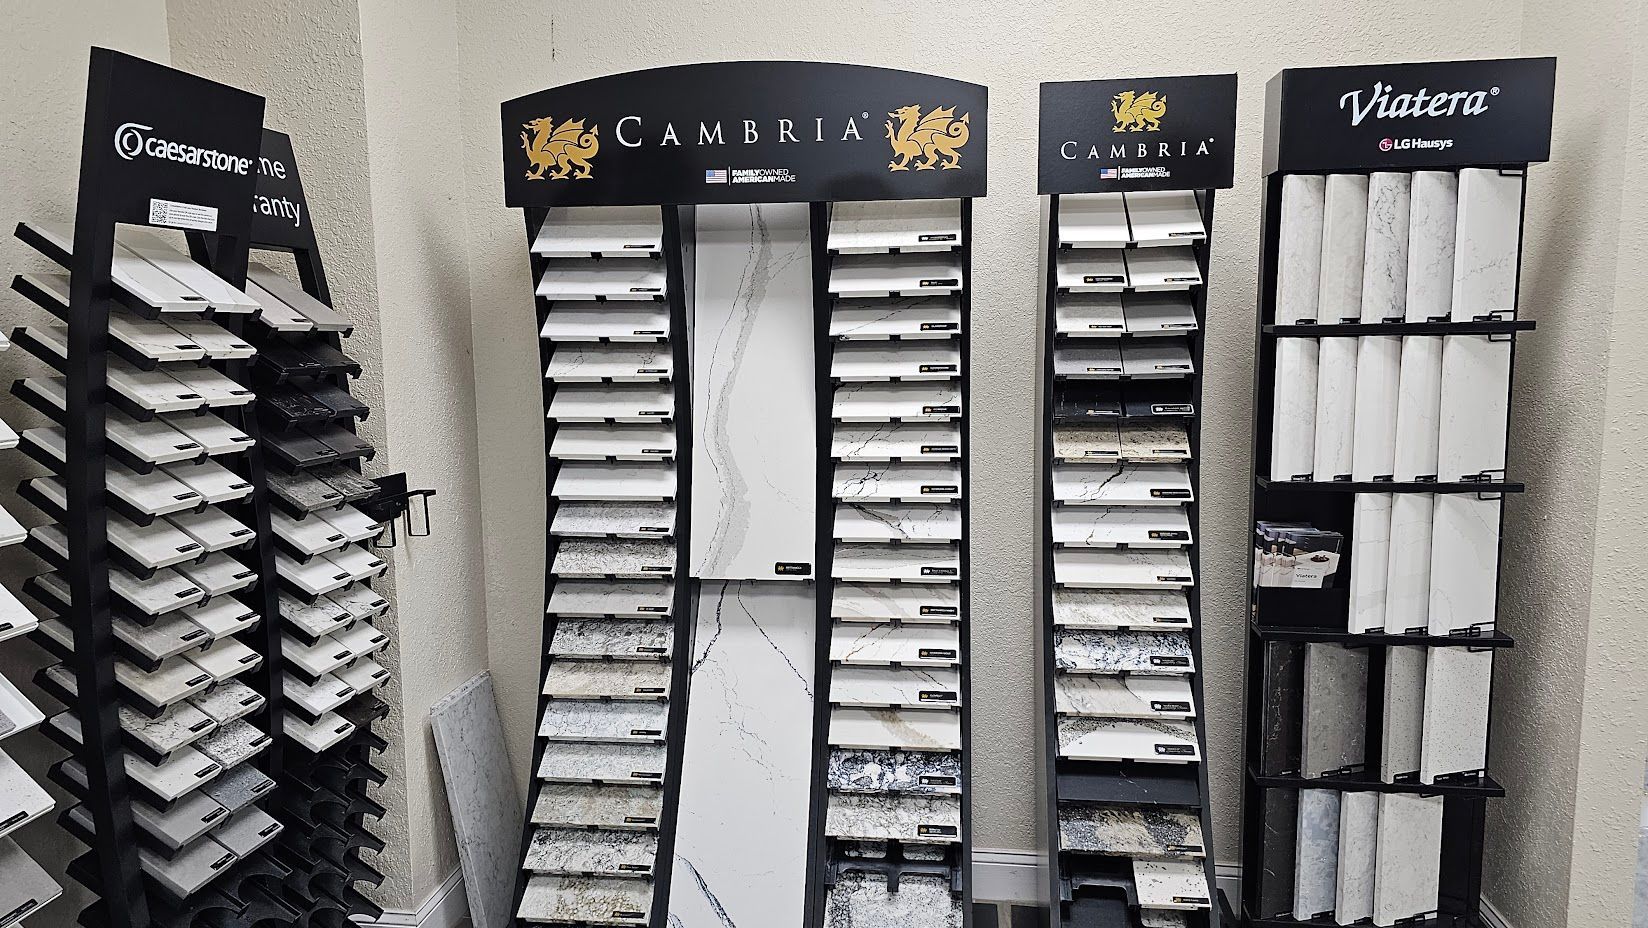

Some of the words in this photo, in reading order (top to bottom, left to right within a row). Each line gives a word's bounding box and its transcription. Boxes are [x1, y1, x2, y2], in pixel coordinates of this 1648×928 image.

[145, 137, 248, 175] caesarstone
[1393, 138, 1411, 150] LG
[1411, 137, 1453, 151] Hausys
